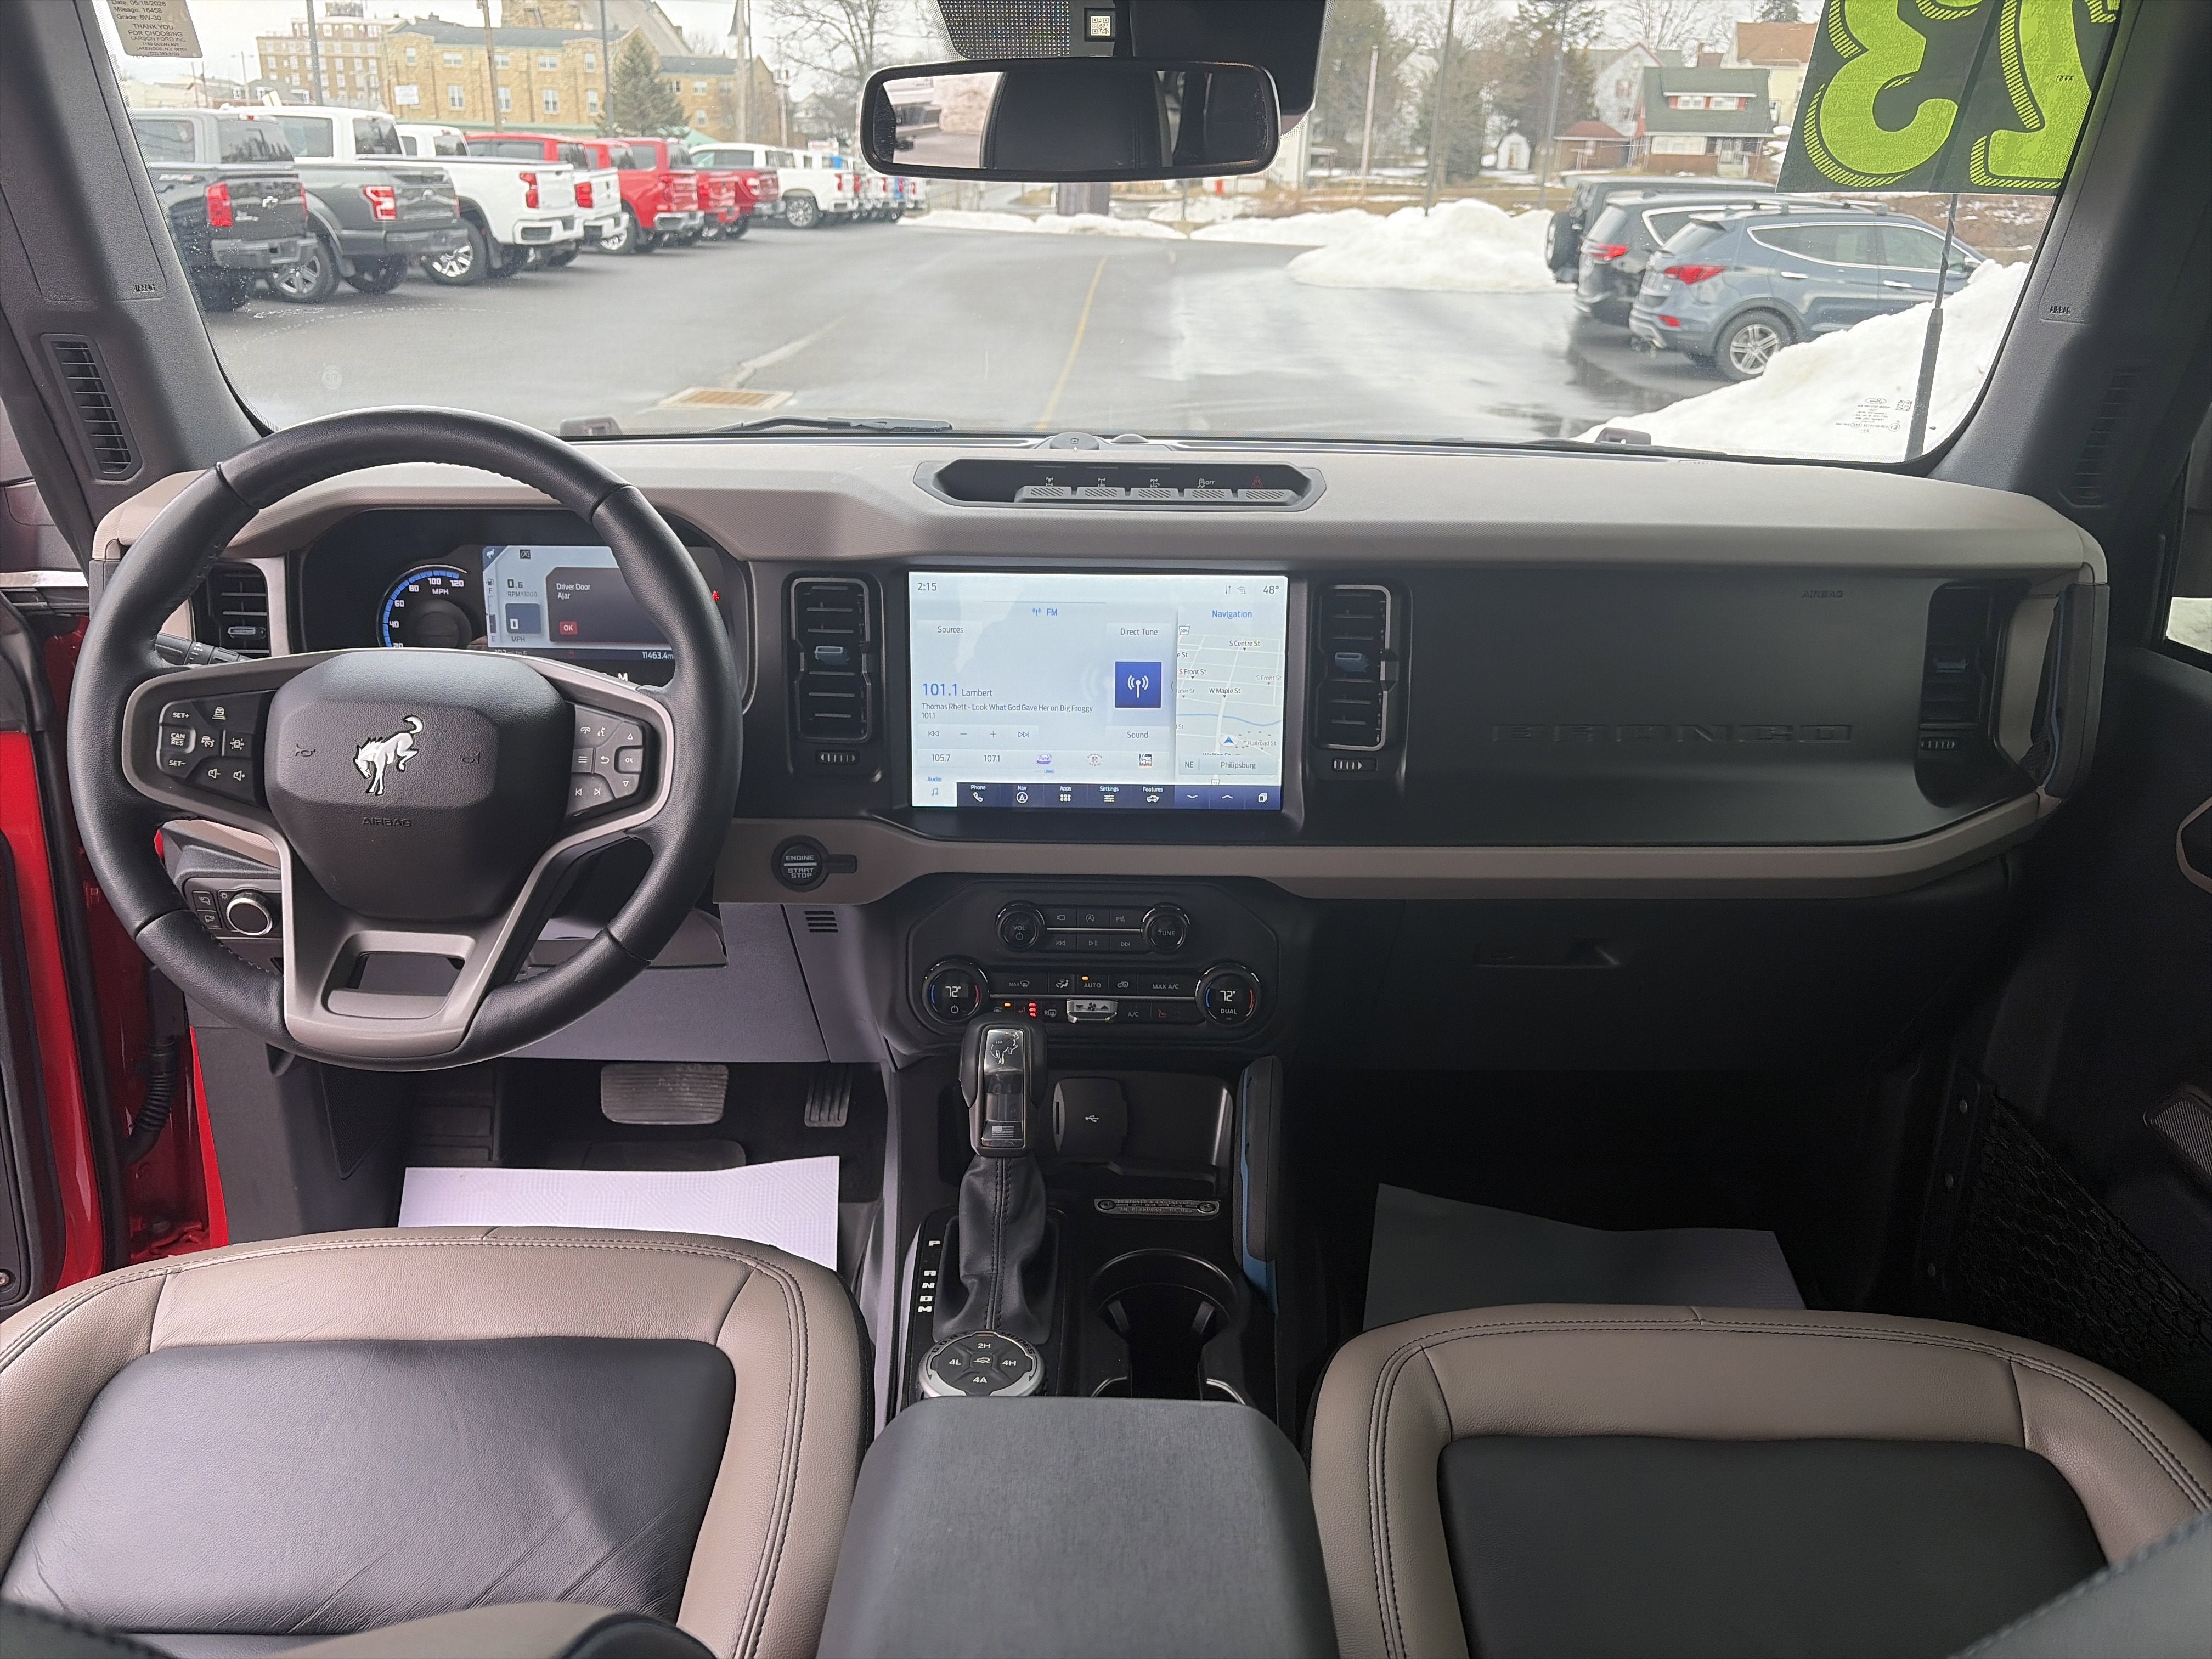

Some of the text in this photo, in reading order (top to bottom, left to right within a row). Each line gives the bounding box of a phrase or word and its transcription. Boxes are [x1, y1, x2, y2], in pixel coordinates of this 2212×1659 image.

[507, 579, 523, 589] 0.6
[917, 583, 937, 591] 2:15
[1263, 585, 1279, 594] 48°
[1212, 610, 1252, 619] Navigation
[510, 619, 518, 630] 0
[618, 673, 628, 681] M
[923, 684, 993, 697] 101.1 Lambert
[1071, 705, 1093, 713] Froggy
[932, 754, 951, 762] 105.7
[1221, 761, 1256, 770] Philipsburg
[362, 817, 411, 827] AIRBAG
[945, 986, 961, 998] 72°
[1220, 990, 1236, 1002] 72°
[1001, 1331, 1036, 1355] MODES
